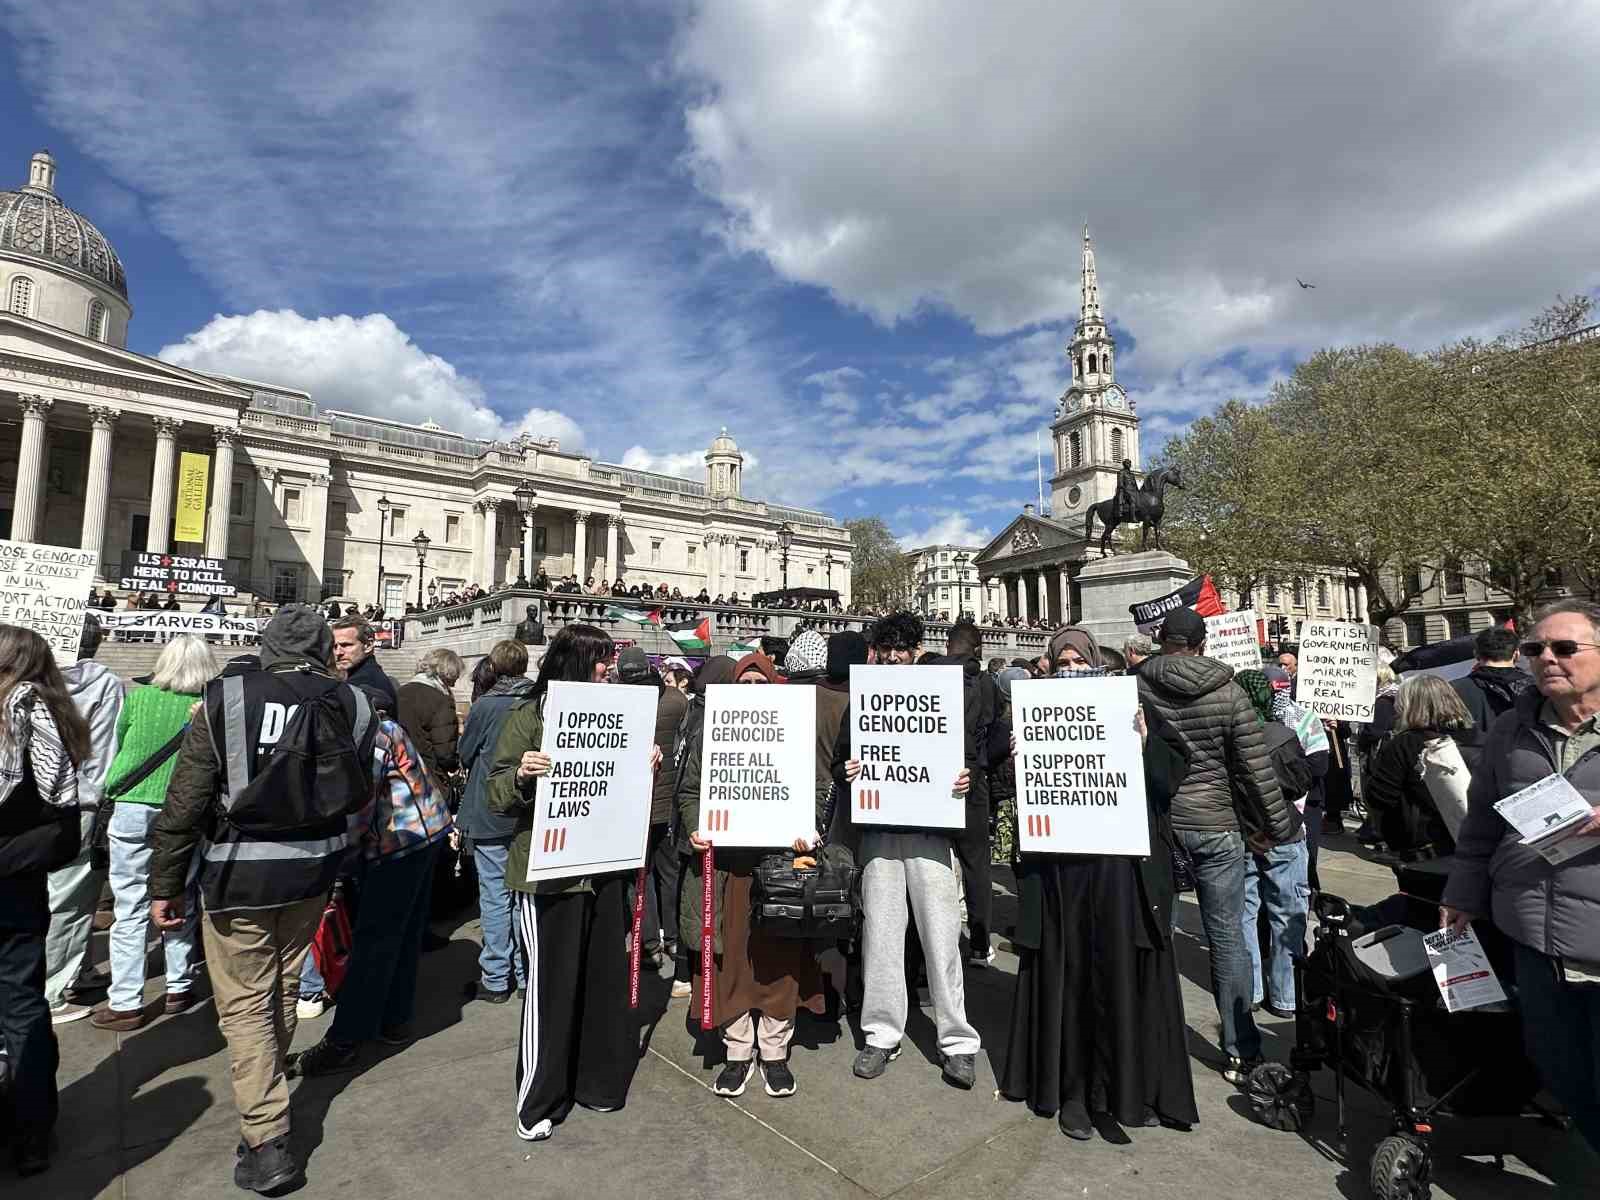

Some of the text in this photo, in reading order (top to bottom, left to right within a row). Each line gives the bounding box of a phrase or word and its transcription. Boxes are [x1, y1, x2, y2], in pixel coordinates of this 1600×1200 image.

[184, 469, 194, 509] NATIONAL
[193, 470, 204, 511] GALLERY
[33, 549, 96, 567] GENOCIDE
[24, 562, 85, 577] ZIONIST
[133, 566, 226, 583] HERE TO KILL
[6, 576, 20, 585] IN
[133, 615, 214, 629] STARVES
[1219, 625, 1250, 637] PROTEST
[1302, 639, 1376, 652] GOVERNMENT
[1306, 656, 1372, 666] LOOK IN THE
[1341, 680, 1357, 688] THE
[1313, 687, 1345, 698] REAL
[860, 694, 941, 712] I OPPOSE
[558, 711, 625, 730] I OPPOSE
[712, 710, 779, 725] I OPPOSE
[1022, 706, 1097, 722] I OPPOSE
[859, 715, 948, 734] GENOCIDE
[556, 731, 629, 749] GENOCIDE
[712, 727, 785, 742] GENOCIDE
[1023, 725, 1106, 741] GENOCIDE
[710, 752, 775, 767] FREE ALL
[860, 744, 901, 762] FREE
[551, 760, 616, 779] ABOLISH
[1023, 754, 1106, 770] I SUPPORT
[709, 769, 782, 784] POLITICAL
[860, 764, 930, 784] AL AQSA
[1024, 772, 1127, 788] PALESTINIAN
[550, 780, 609, 798] TERROR
[709, 786, 790, 801] PRISONERS
[1026, 790, 1118, 806] LIBERATION
[547, 801, 591, 819] LAWS
